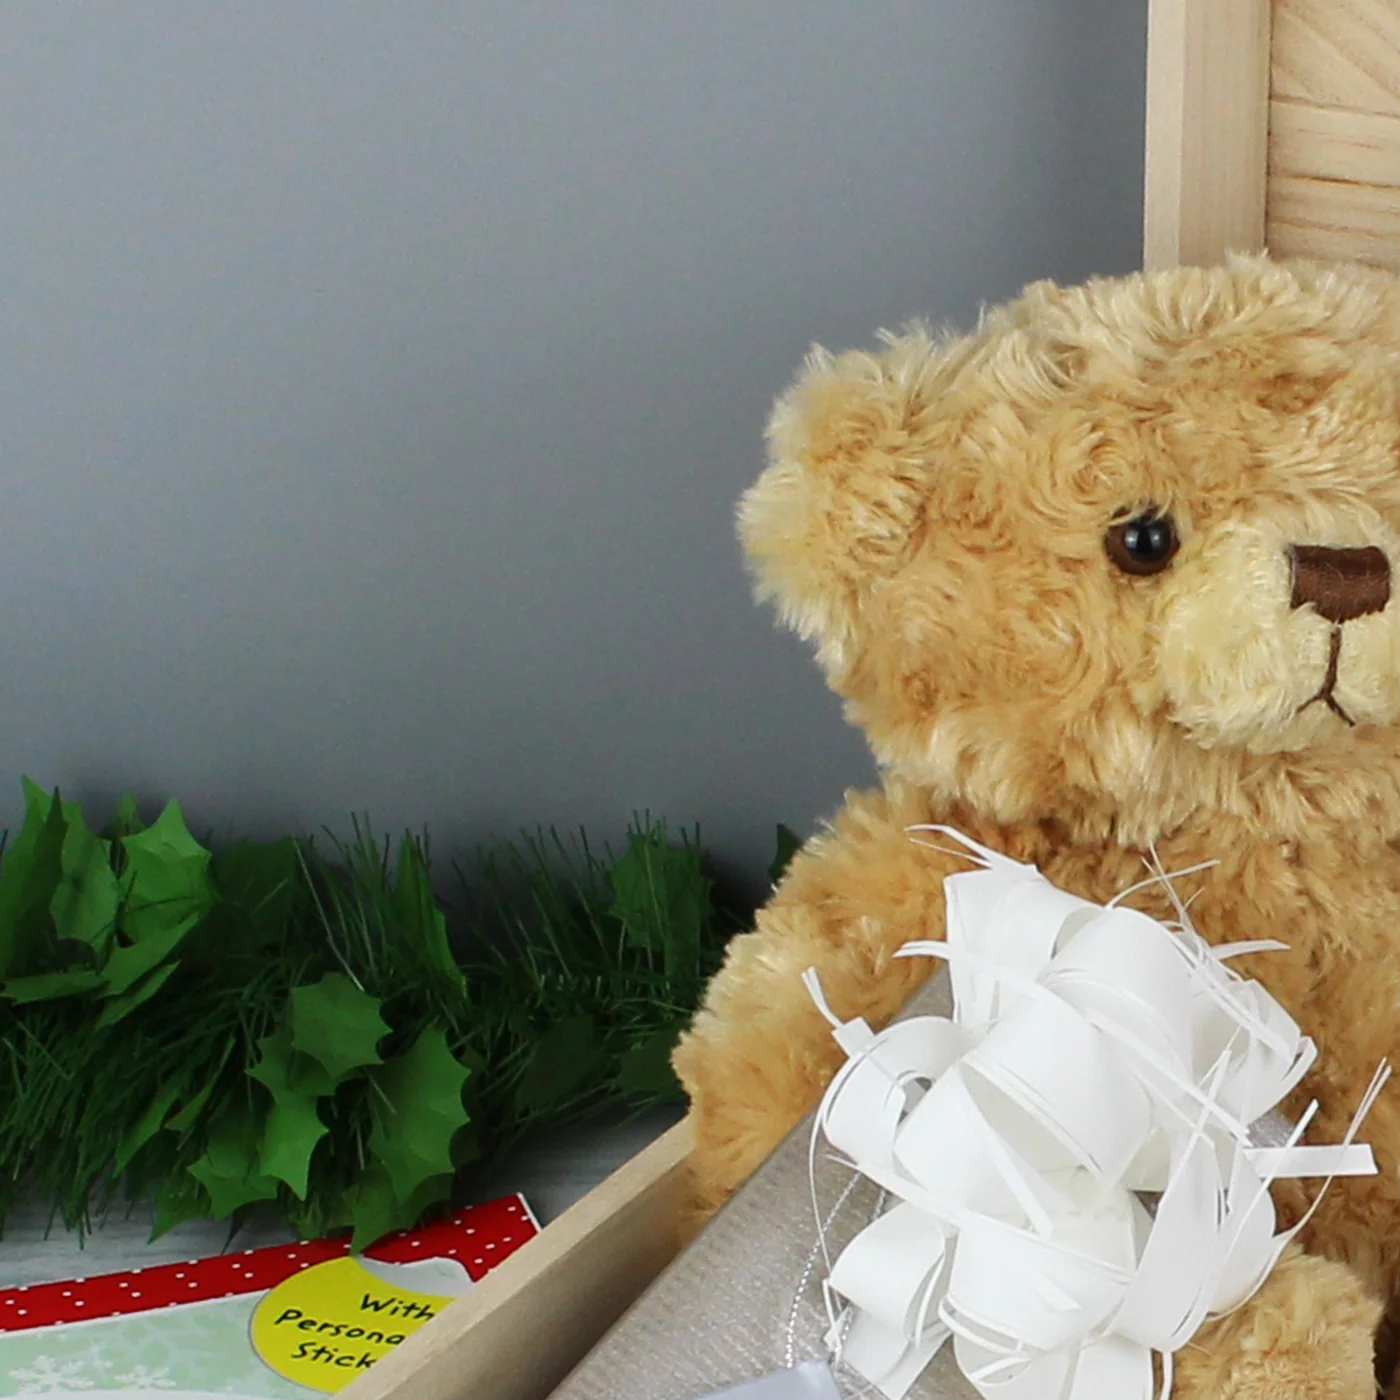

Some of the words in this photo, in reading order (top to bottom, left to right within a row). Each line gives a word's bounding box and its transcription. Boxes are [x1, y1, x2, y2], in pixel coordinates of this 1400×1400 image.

[359, 1293, 436, 1321] With
[274, 1308, 407, 1345] Persona
[291, 1341, 379, 1370] Stick
